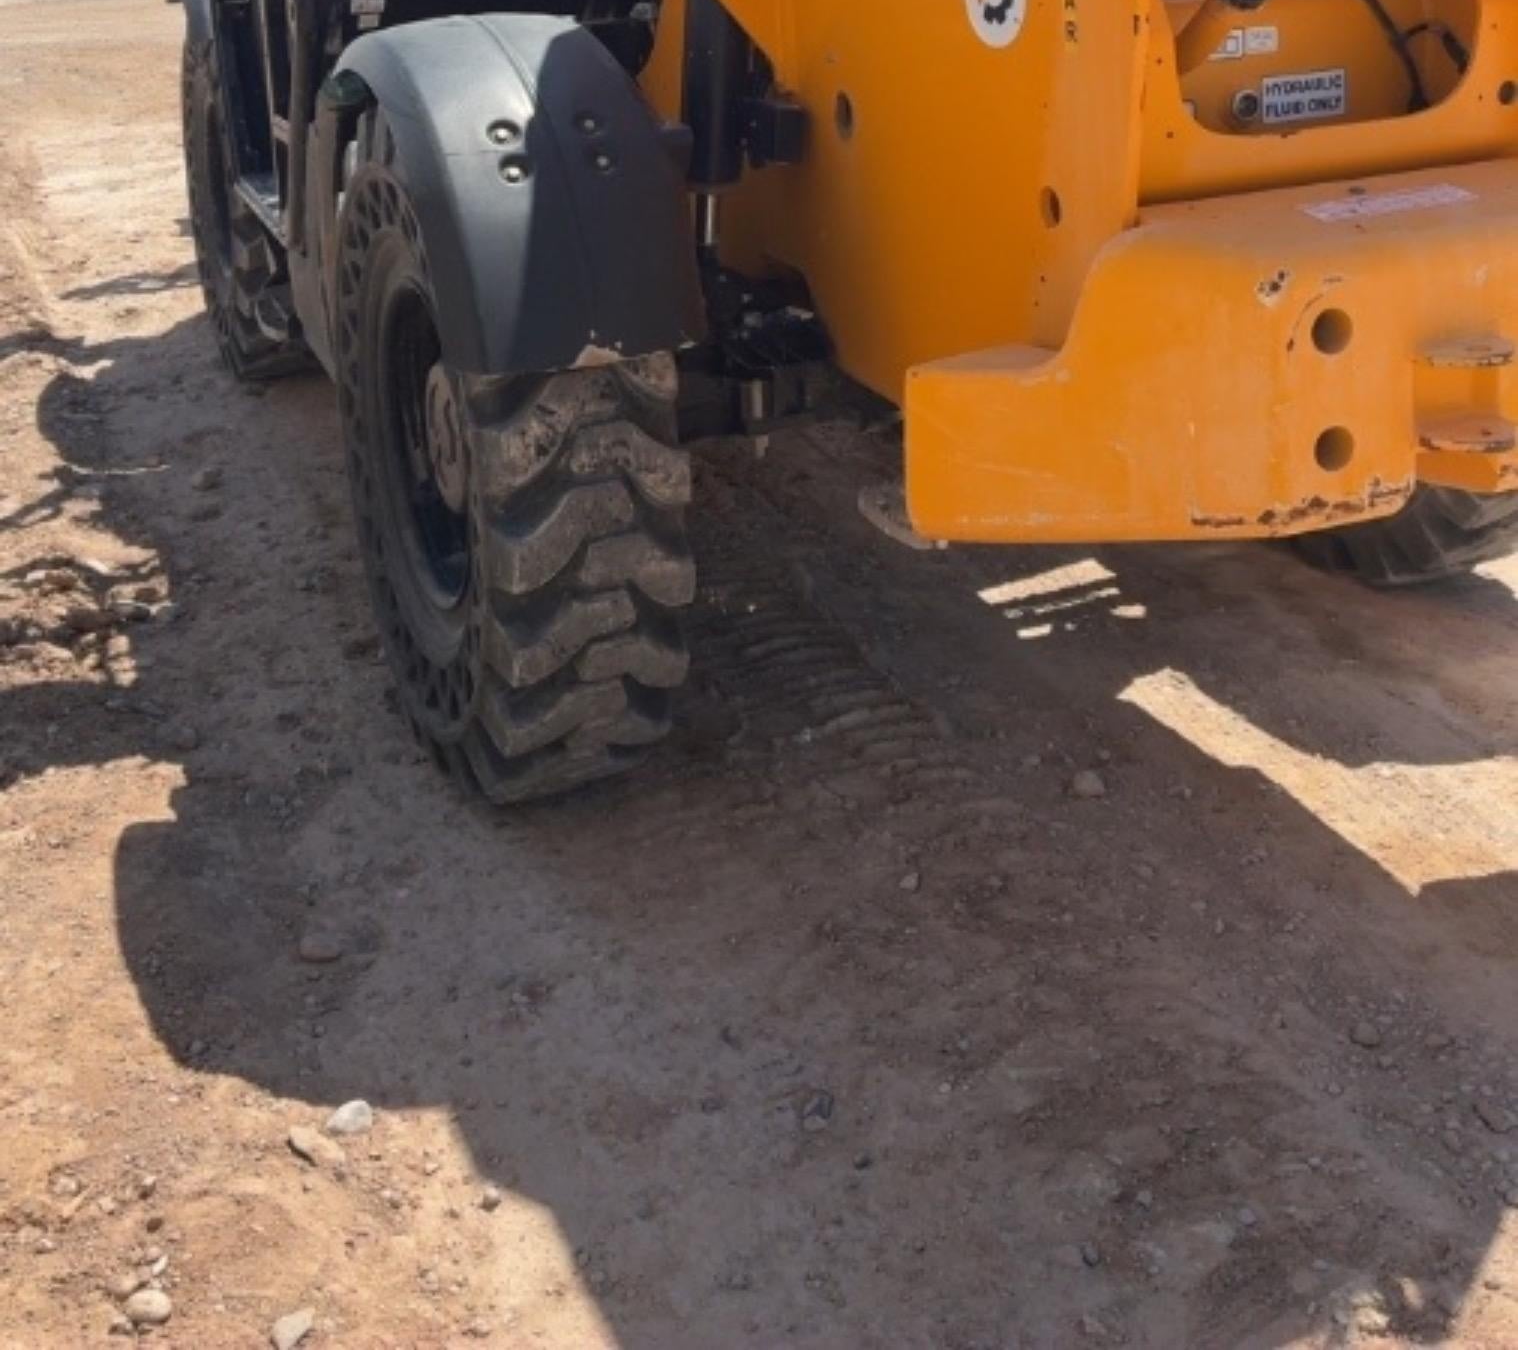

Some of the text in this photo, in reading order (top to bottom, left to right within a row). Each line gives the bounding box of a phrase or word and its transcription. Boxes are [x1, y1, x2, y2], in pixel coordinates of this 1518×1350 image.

[1264, 73, 1343, 98] HYDRAULIC
[1264, 97, 1343, 118] FLUID ONLY
